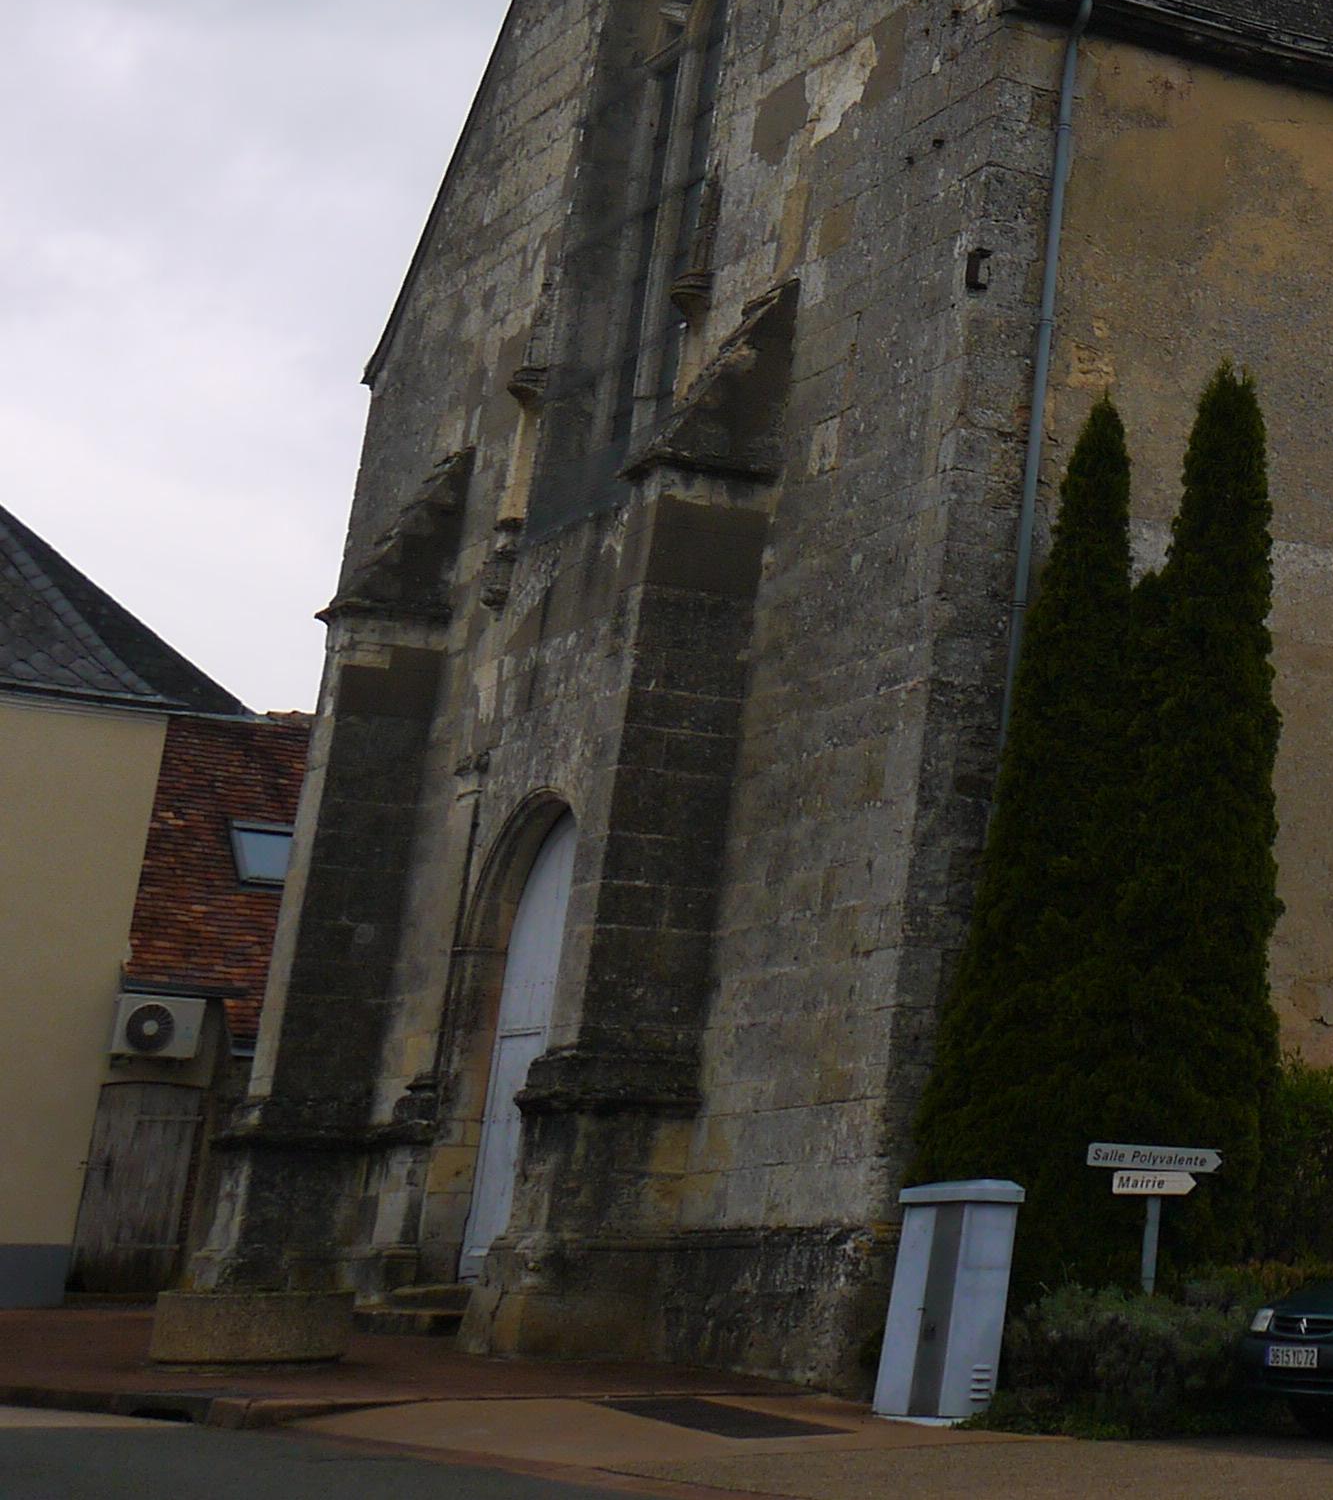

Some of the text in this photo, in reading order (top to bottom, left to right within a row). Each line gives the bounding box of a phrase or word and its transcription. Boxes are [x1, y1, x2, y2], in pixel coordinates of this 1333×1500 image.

[1092, 1148, 1207, 1168] Salle Polyvalente
[1117, 1175, 1166, 1189] Mairie
